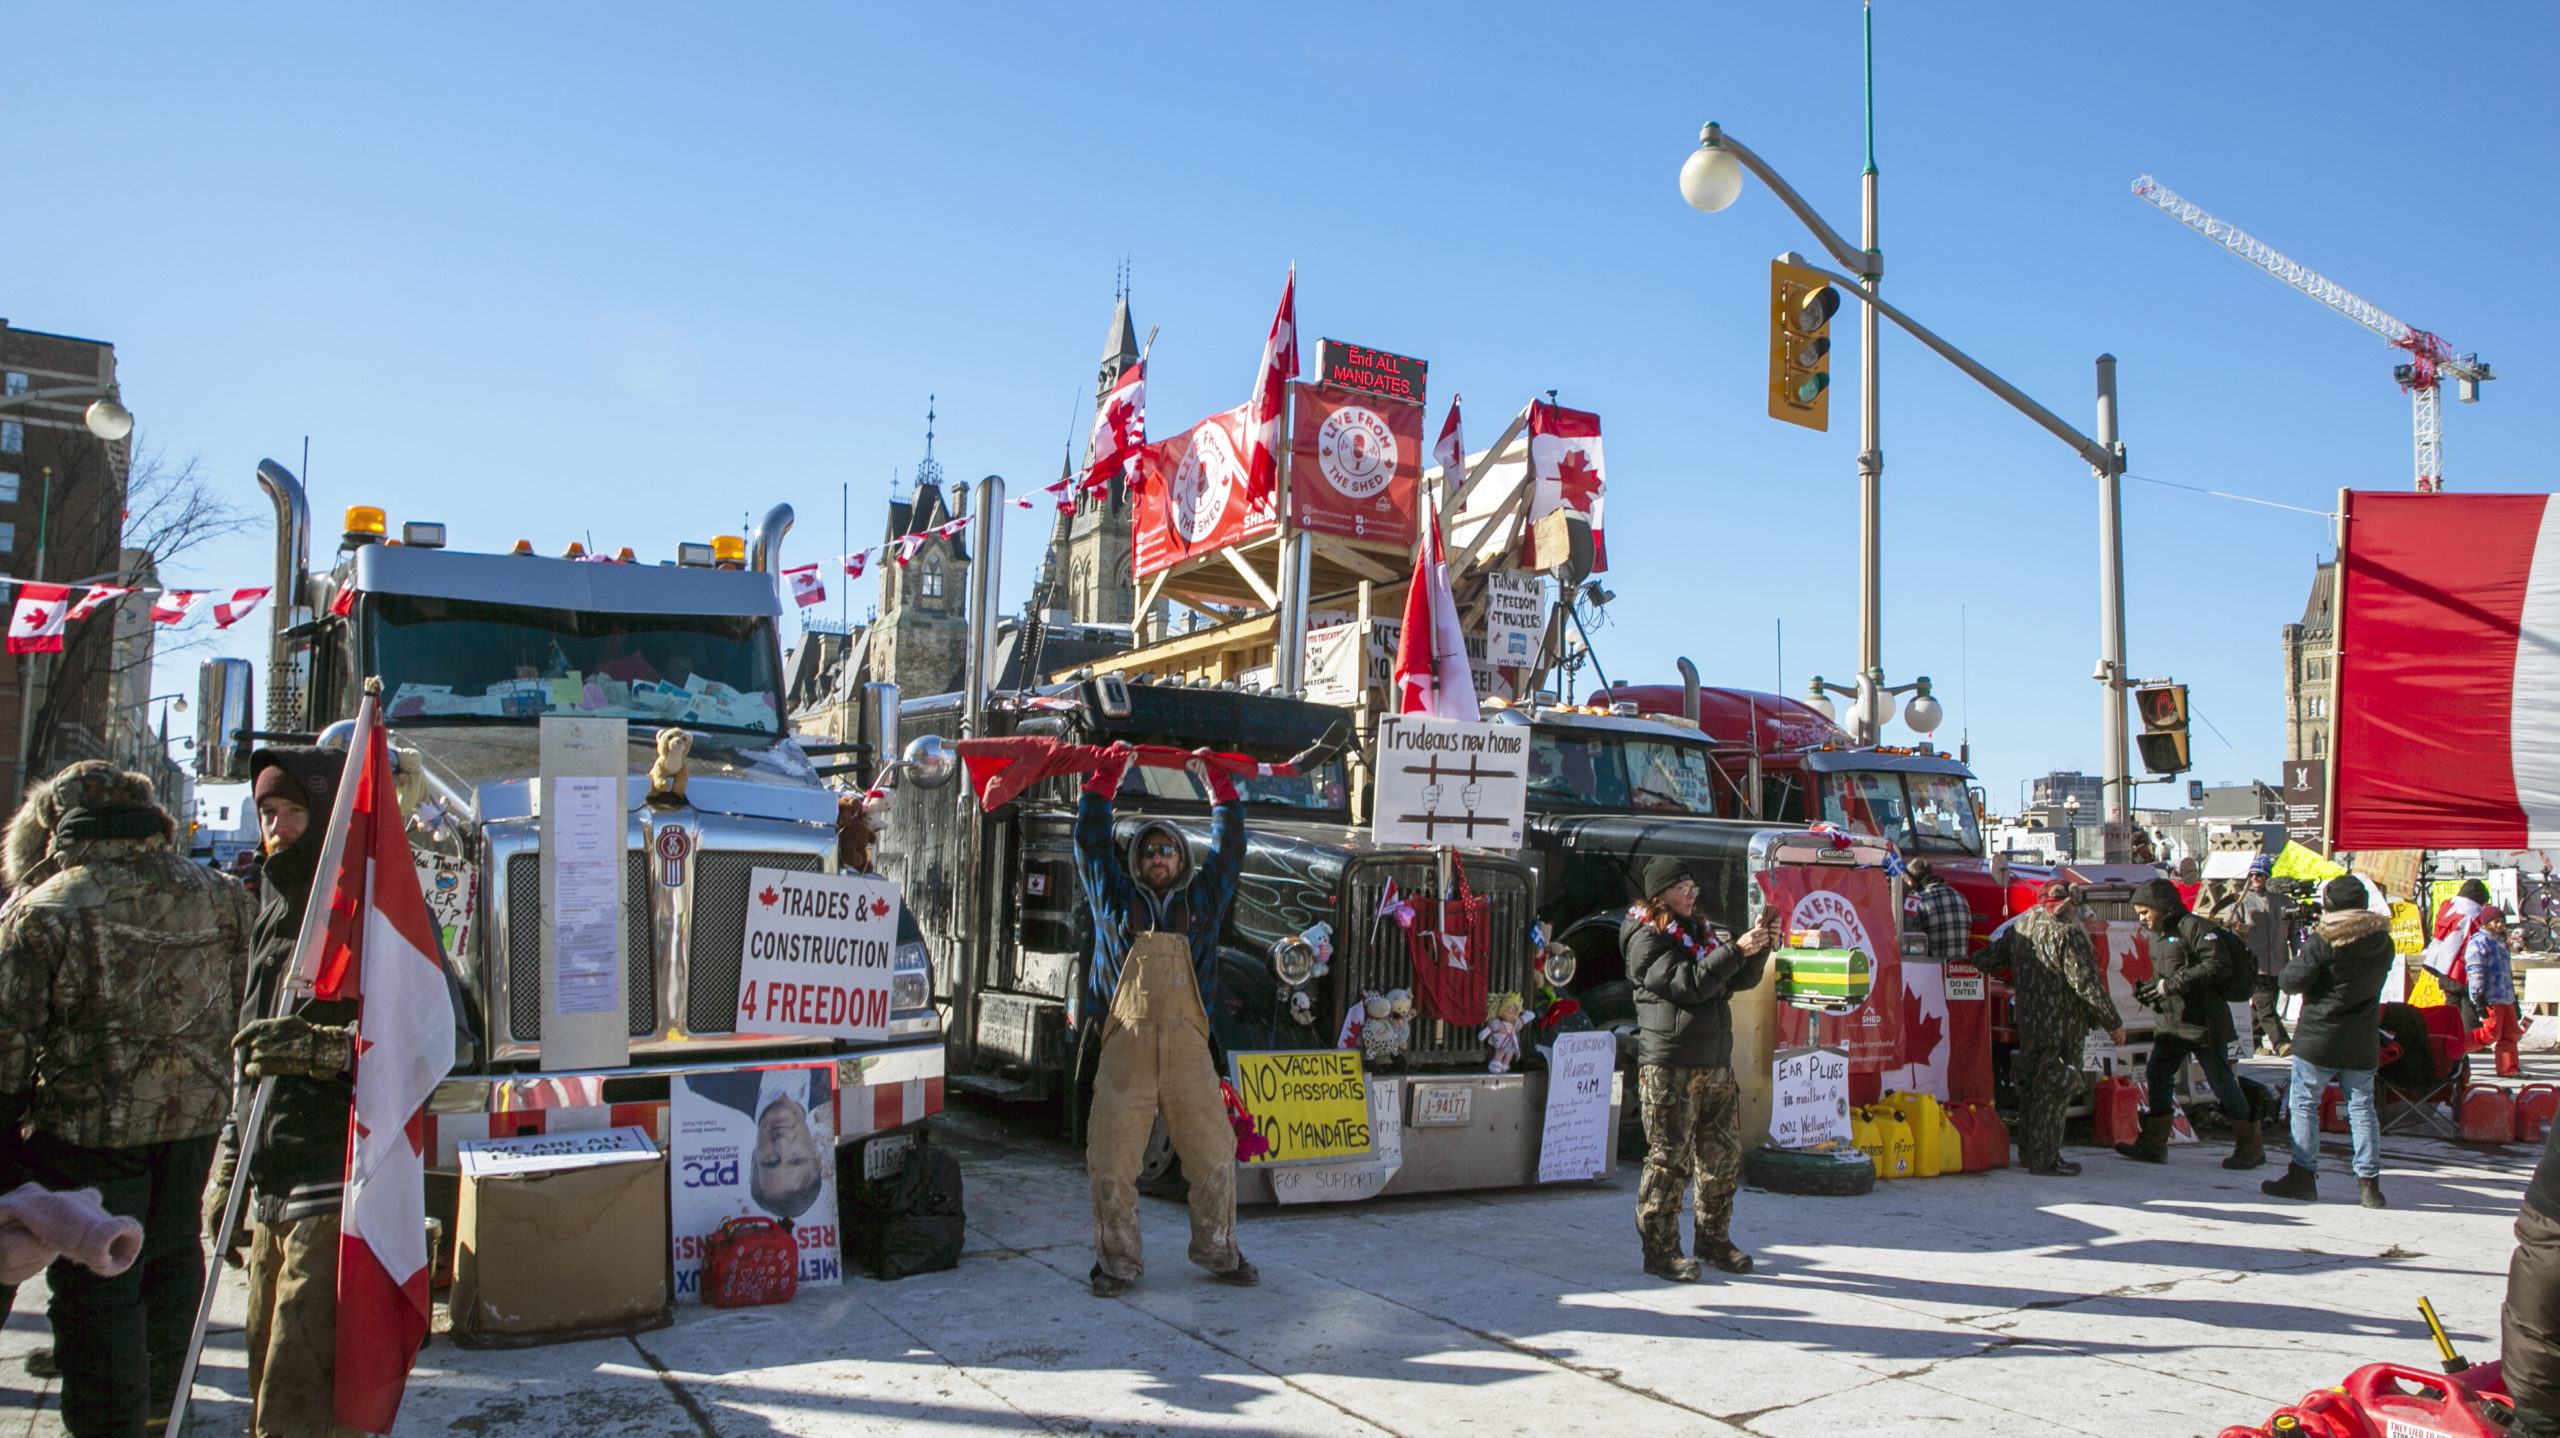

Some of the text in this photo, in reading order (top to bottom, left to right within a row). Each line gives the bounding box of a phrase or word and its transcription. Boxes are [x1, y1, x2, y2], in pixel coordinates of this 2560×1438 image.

[1349, 349, 1400, 375] End ALL
[1334, 365, 1410, 395] MANDATES
[1324, 412, 1391, 449] LIVE FROM
[1329, 465, 1383, 492] THE SHED
[1179, 500, 1221, 535] THE SHED
[1491, 575, 1539, 596] THANK YOU
[1497, 594, 1537, 611] FREEDOM
[1493, 611, 1541, 628] TRUCKERS
[1304, 675, 1338, 687] WATCHING!
[1462, 734, 1485, 751] new
[1488, 730, 1521, 754] home
[782, 887, 869, 922] TRADES &
[1823, 897, 1863, 942] FROM
[751, 930, 889, 969] CONSTRUCTION
[1953, 988, 1977, 996] ENTER
[1963, 980, 1979, 988] NOT
[741, 980, 889, 1028] 4 FREEDOM
[1862, 1015, 1881, 1023] SHED
[1240, 1054, 1355, 1104] NO VACCINE
[1779, 1055, 1843, 1081] EAR PLUGS
[1281, 1078, 1364, 1102] PASSPORTS
[1577, 1078, 1599, 1094] 9AM
[1796, 1087, 1826, 1105] mailbox
[1288, 1118, 1370, 1149] MANDATES
[1801, 1114, 1837, 1136] Wellington
[481, 1135, 630, 1153] WE ARE ALL
[701, 1146, 733, 1154] CANADA
[683, 1160, 739, 1188] PPC
[1275, 1171, 1374, 1192] FOR SUPPORT
[2391, 1421, 2407, 1433] THEY
[2409, 1427, 2424, 1438] LIED
